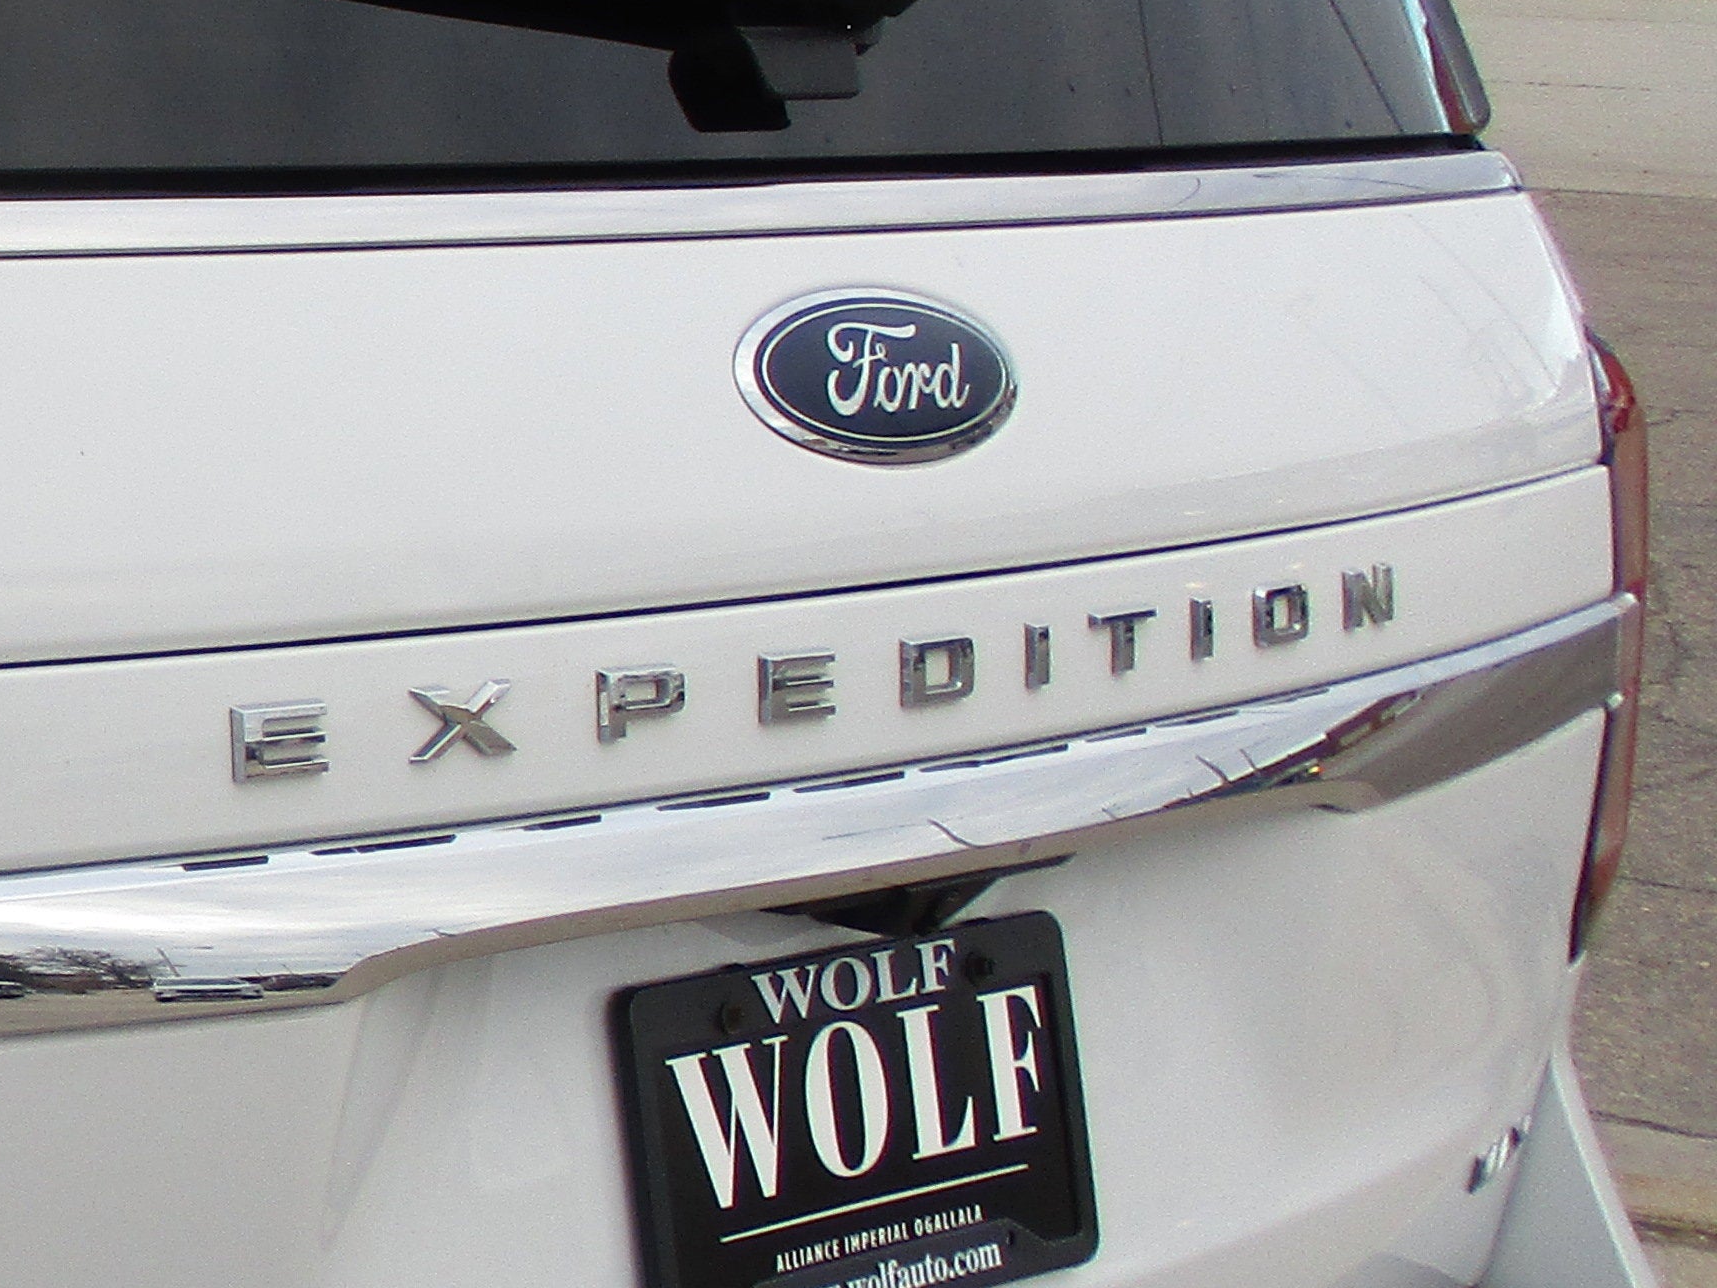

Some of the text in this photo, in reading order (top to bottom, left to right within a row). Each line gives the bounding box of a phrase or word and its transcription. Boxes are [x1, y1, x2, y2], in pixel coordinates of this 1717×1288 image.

[826, 321, 970, 416] Ford
[230, 561, 1397, 784] EXPEDITION
[751, 938, 957, 1024] WOLF
[666, 984, 1044, 1209] WOLF
[776, 1204, 984, 1273] ALLIANCE IMPERIAL OGALLALA
